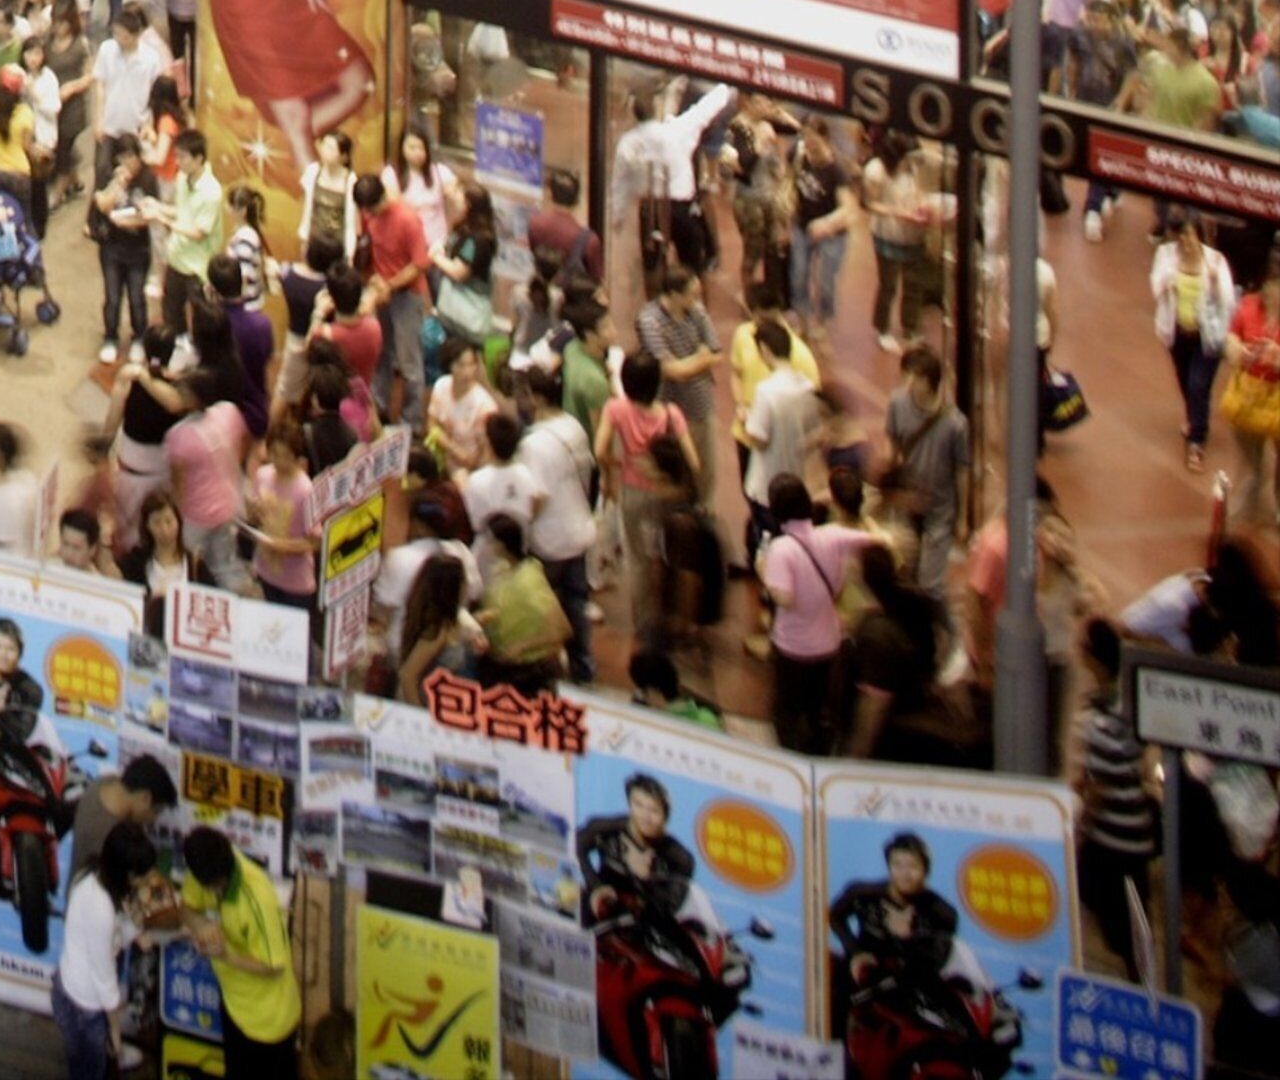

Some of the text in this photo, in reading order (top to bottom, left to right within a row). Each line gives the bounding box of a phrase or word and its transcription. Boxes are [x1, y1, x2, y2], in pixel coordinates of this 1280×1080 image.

[850, 67, 1076, 171] SOGO
[424, 667, 588, 756] 包合格
[1144, 676, 1203, 708] East
